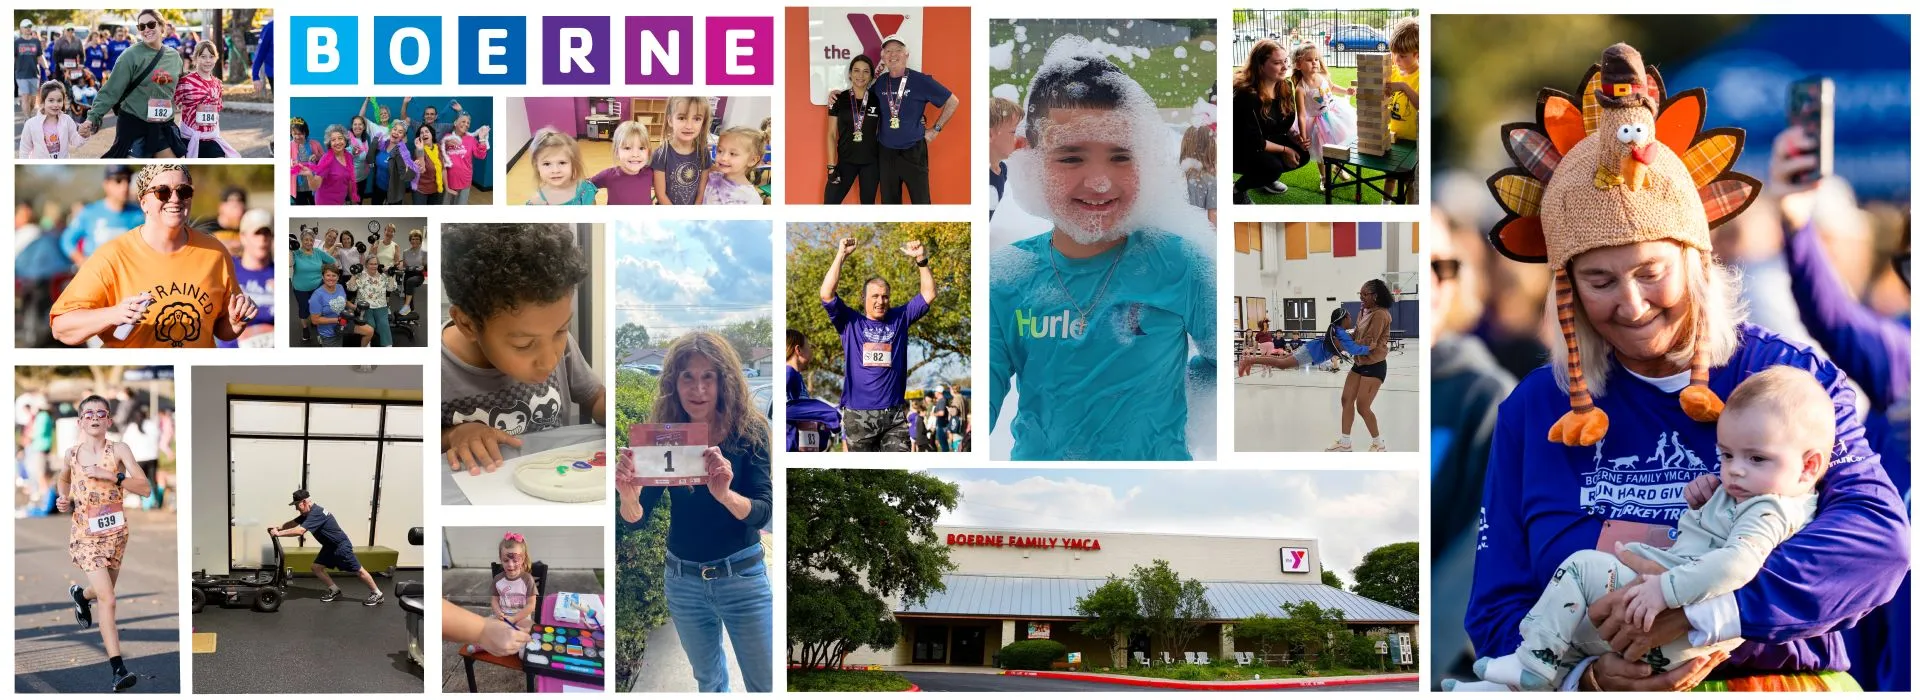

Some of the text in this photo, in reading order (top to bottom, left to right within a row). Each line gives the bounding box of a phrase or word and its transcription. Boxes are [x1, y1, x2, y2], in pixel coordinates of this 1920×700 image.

[824, 45, 850, 59] the
[154, 108, 168, 117] 182
[202, 113, 215, 121] 184
[147, 281, 214, 315] RAINED
[1015, 309, 1087, 340] Hurle
[873, 352, 884, 362] 82
[808, 433, 816, 445] 83
[664, 450, 675, 472] 1
[1625, 472, 1662, 484] FAMILY
[1664, 470, 1691, 481] YMCA
[1617, 487, 1657, 501] HARD
[1660, 486, 1684, 500] GIV
[1610, 504, 1663, 519] TURKEY
[1663, 507, 1687, 520] TRO
[97, 515, 116, 529] 639
[947, 533, 1101, 550] BOERNE FAMILY YMCA
